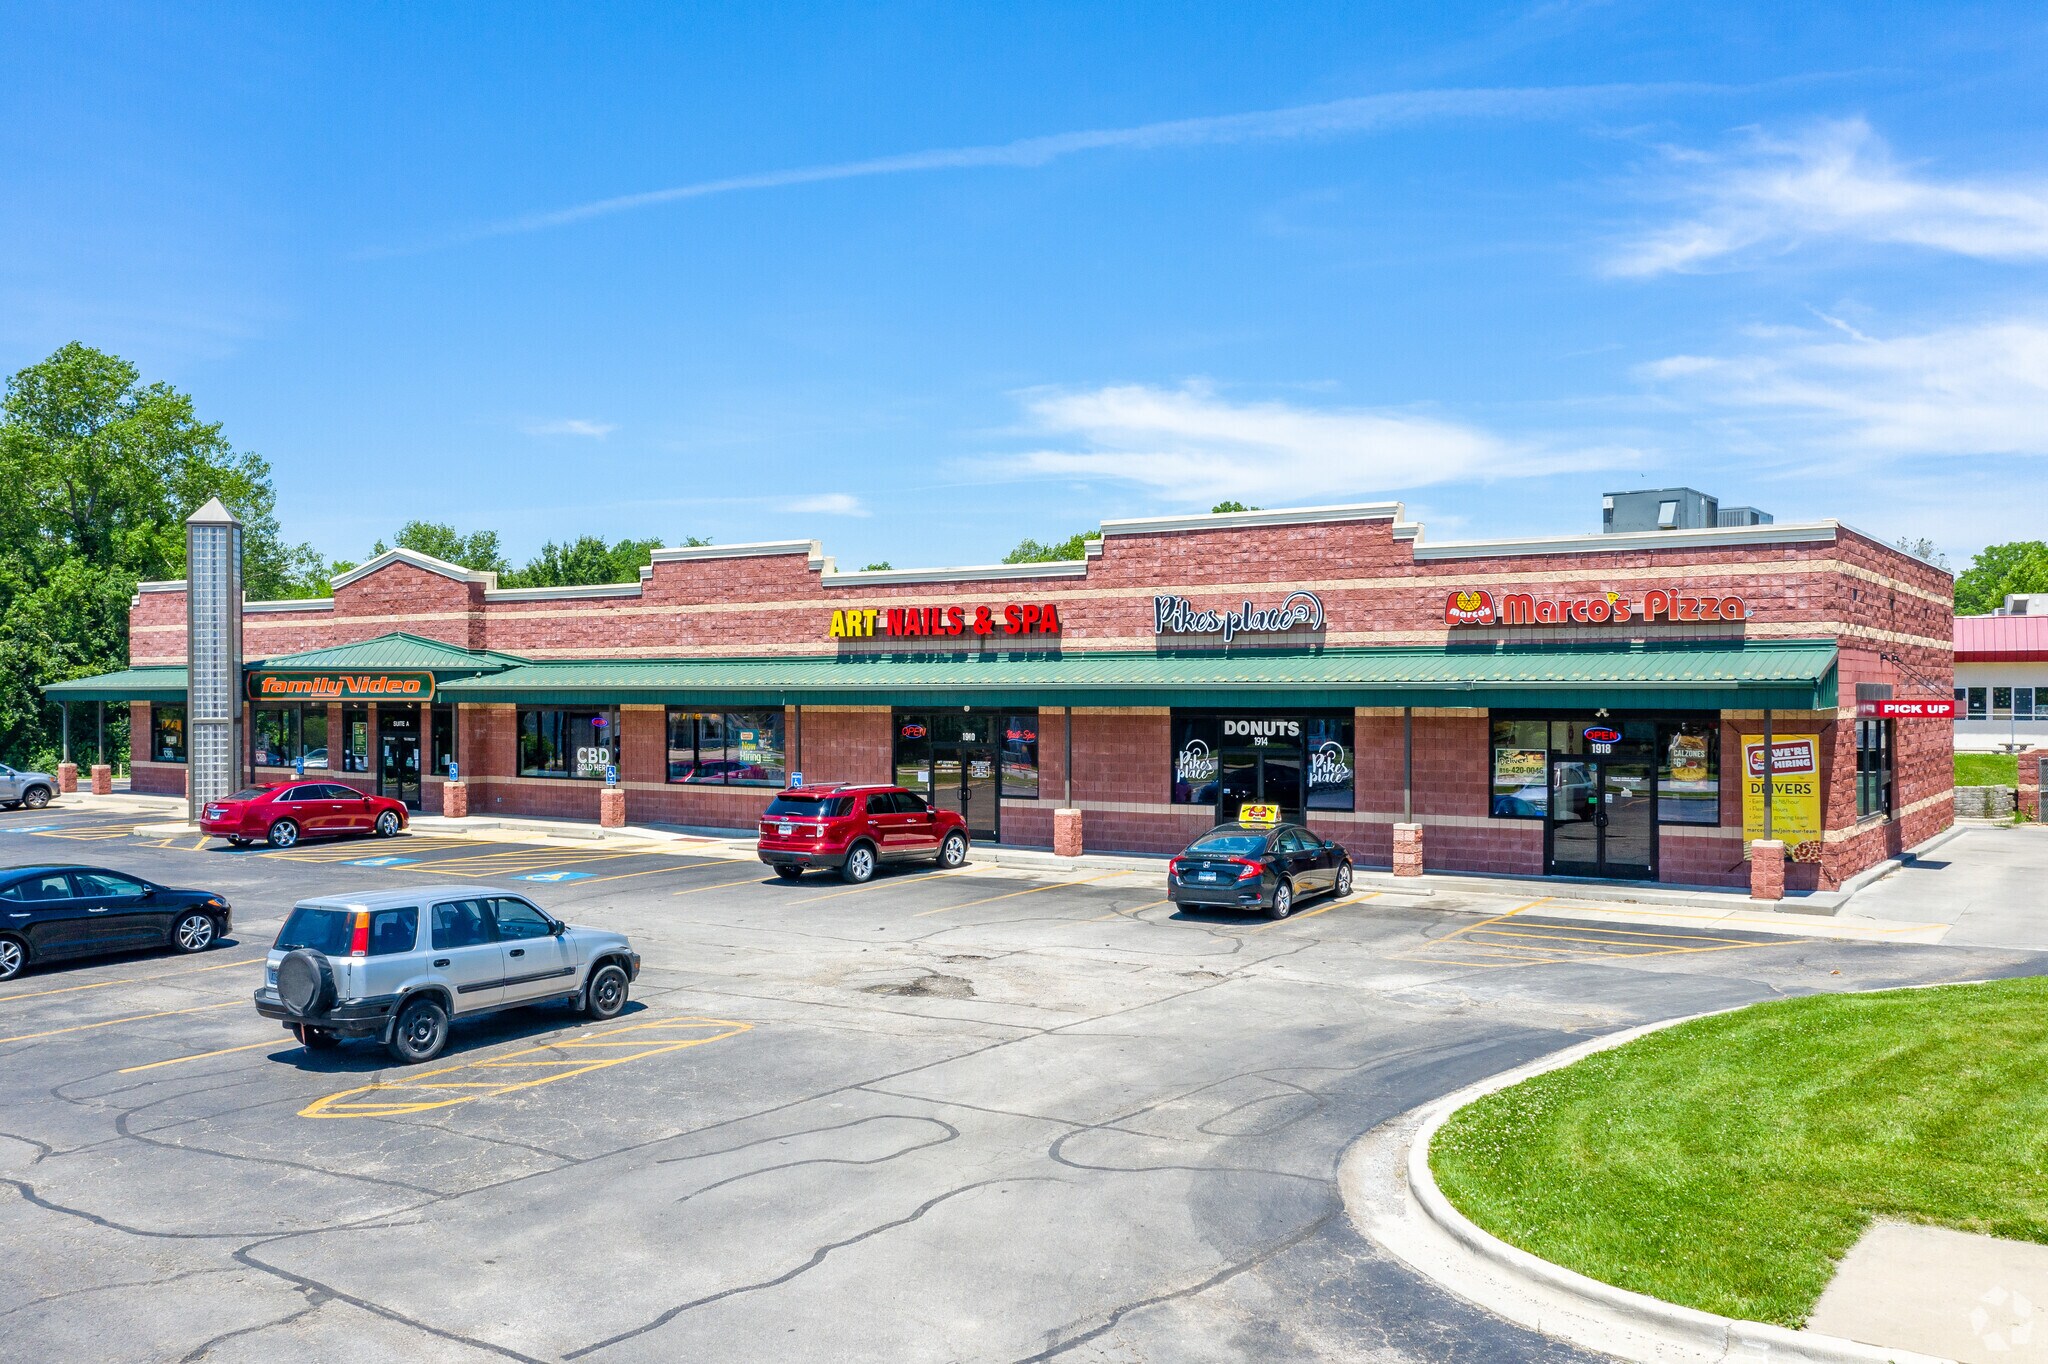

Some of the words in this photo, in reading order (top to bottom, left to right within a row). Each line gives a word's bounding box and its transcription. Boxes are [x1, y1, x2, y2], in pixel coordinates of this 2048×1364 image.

[1154, 594, 1222, 633] Pikes
[1502, 591, 1632, 625] Marco's
[1643, 588, 1745, 622] Pizza
[829, 609, 878, 637] ART
[886, 606, 965, 636] NAILS
[973, 605, 995, 635] &
[1004, 603, 1059, 634] SPA
[262, 677, 344, 697] family
[339, 676, 421, 693] Video
[1884, 704, 1923, 714] PICK
[1927, 704, 1950, 714] UP
[902, 727, 927, 737] OPEN
[1224, 720, 1300, 737] DONUTS
[1585, 731, 1618, 740] OPEN
[741, 741, 757, 750] Now
[1254, 737, 1268, 746] 1914
[1592, 743, 1611, 754] 1918
[577, 747, 610, 764] CBD
[740, 749, 762, 764] Hiring
[1772, 746, 1809, 757] WE'RE
[577, 763, 593, 771] SOLD
[1179, 750, 1213, 771] Pikes
[1312, 753, 1349, 774] Pikes
[1774, 758, 1811, 769] HIRING
[1177, 765, 1214, 783] place
[1309, 768, 1350, 788] place
